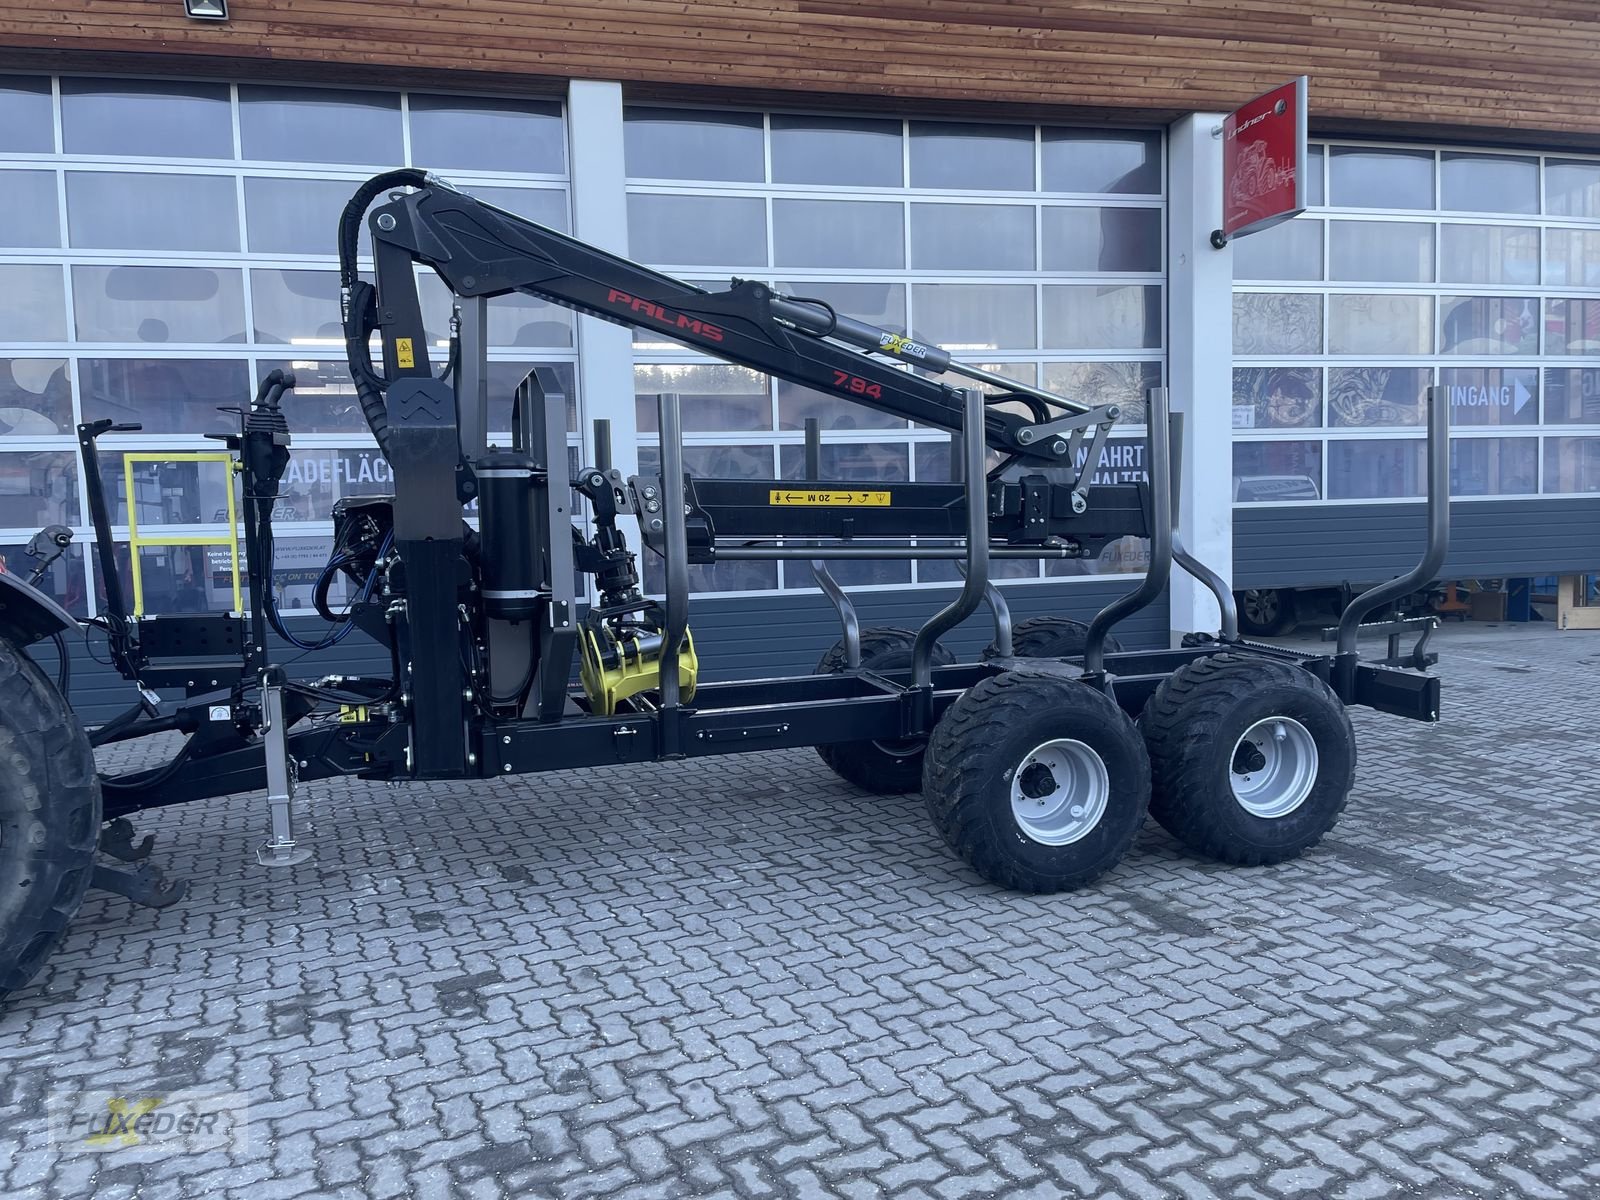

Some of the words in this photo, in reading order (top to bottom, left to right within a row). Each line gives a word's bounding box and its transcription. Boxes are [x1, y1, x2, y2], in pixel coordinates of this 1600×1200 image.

[1227, 110, 1272, 140] Lindner
[607, 288, 725, 342] PALMS
[833, 369, 882, 399] 7.94
[1449, 387, 1509, 406] INGANG
[278, 453, 394, 483] ADEFLÄC
[1072, 446, 1145, 468] NAHRT
[807, 494, 815, 502] M
[818, 494, 830, 502] 20
